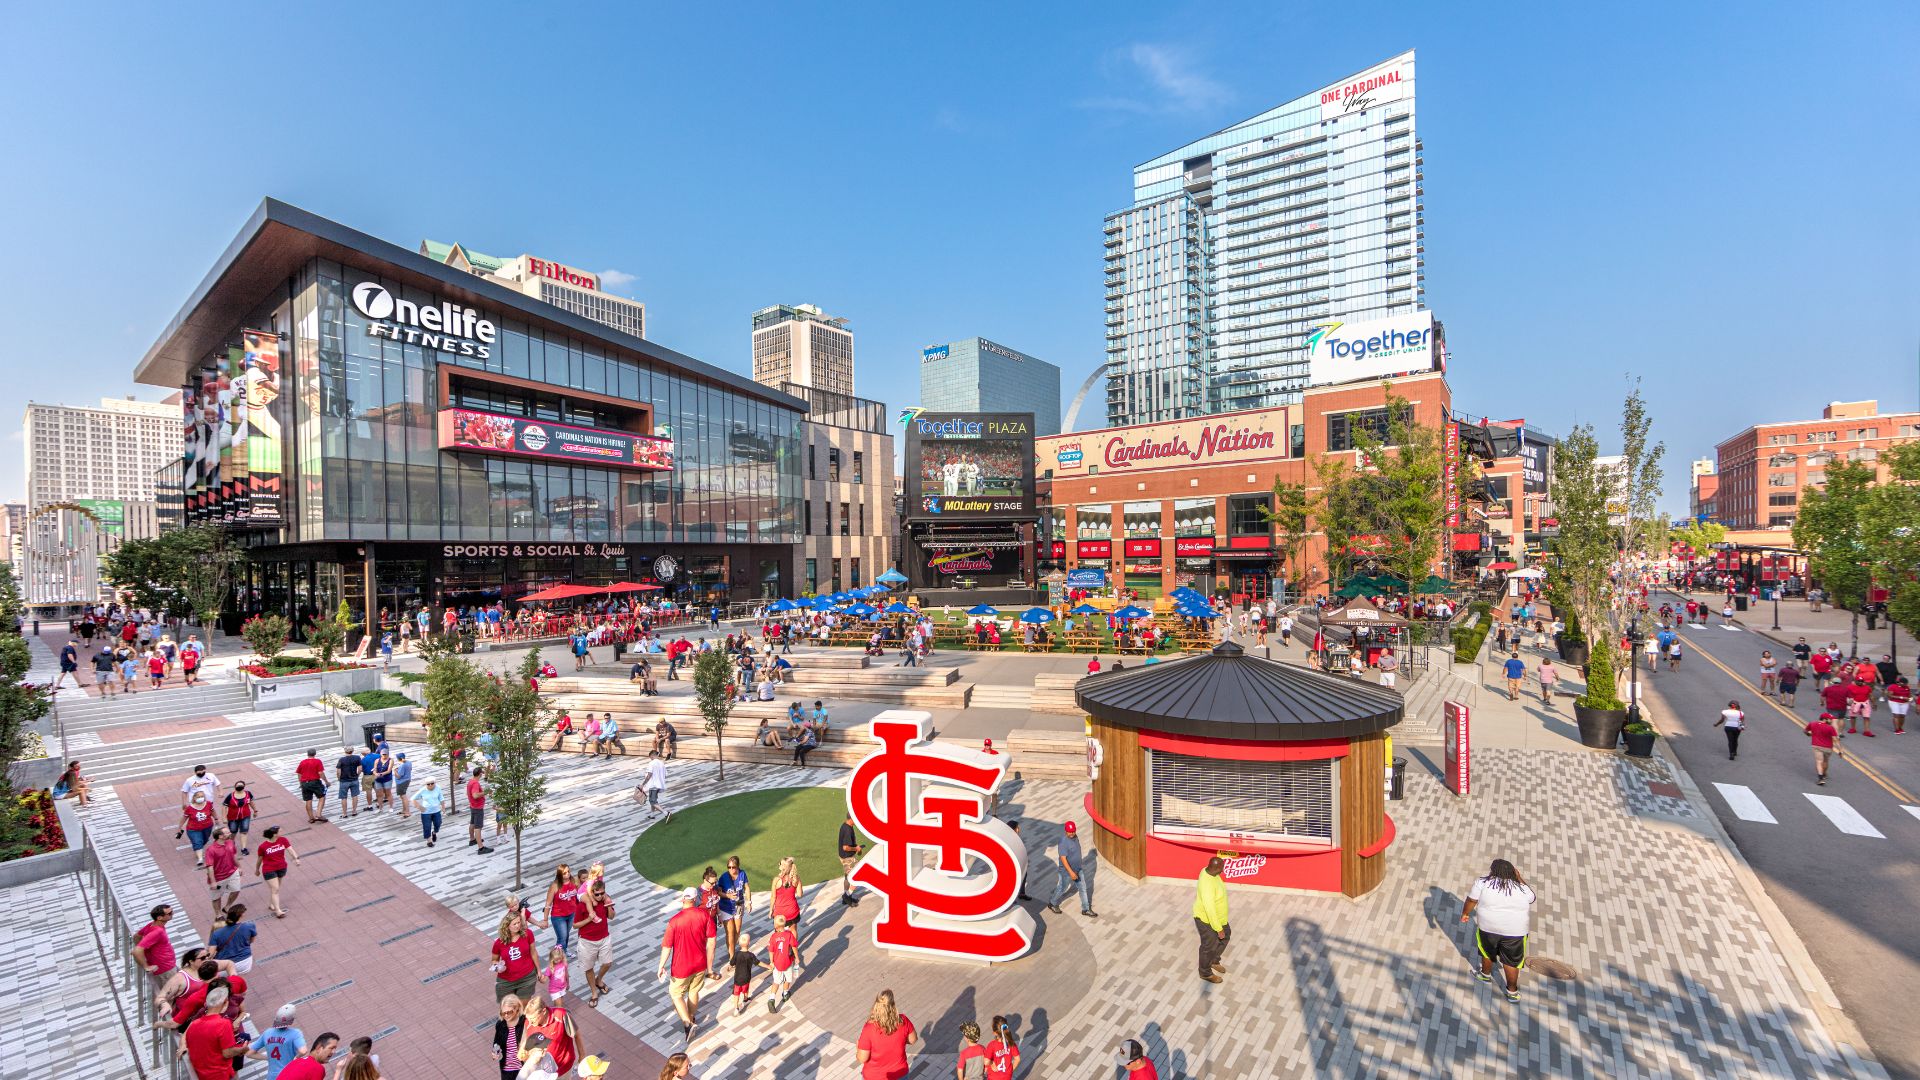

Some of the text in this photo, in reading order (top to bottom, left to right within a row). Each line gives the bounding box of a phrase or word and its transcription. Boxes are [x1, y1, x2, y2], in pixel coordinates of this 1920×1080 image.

[1321, 70, 1402, 105] ONE CARDINAL
[529, 257, 595, 289] Hilton
[368, 321, 491, 359] FITNESS
[1325, 328, 1431, 361] Together
[922, 350, 946, 363] KPMG
[1374, 349, 1401, 358] CREDIT
[1402, 345, 1427, 354] UNION
[915, 418, 1027, 438] Together PLAZA
[555, 431, 584, 443] CARDINALS
[584, 435, 602, 445] NATION
[602, 438, 608, 446] IS
[1104, 424, 1274, 468] Cardinals Nation
[943, 501, 1023, 512] MOLottery STAGE
[443, 543, 625, 560] SPORTS & SOCIAL St. Louis
[939, 556, 993, 574] Cardinals
[1223, 854, 1265, 869] Prairie
[1225, 867, 1257, 877] Farms
[270, 1046, 281, 1060] 4
[997, 1057, 1006, 1072] 4
